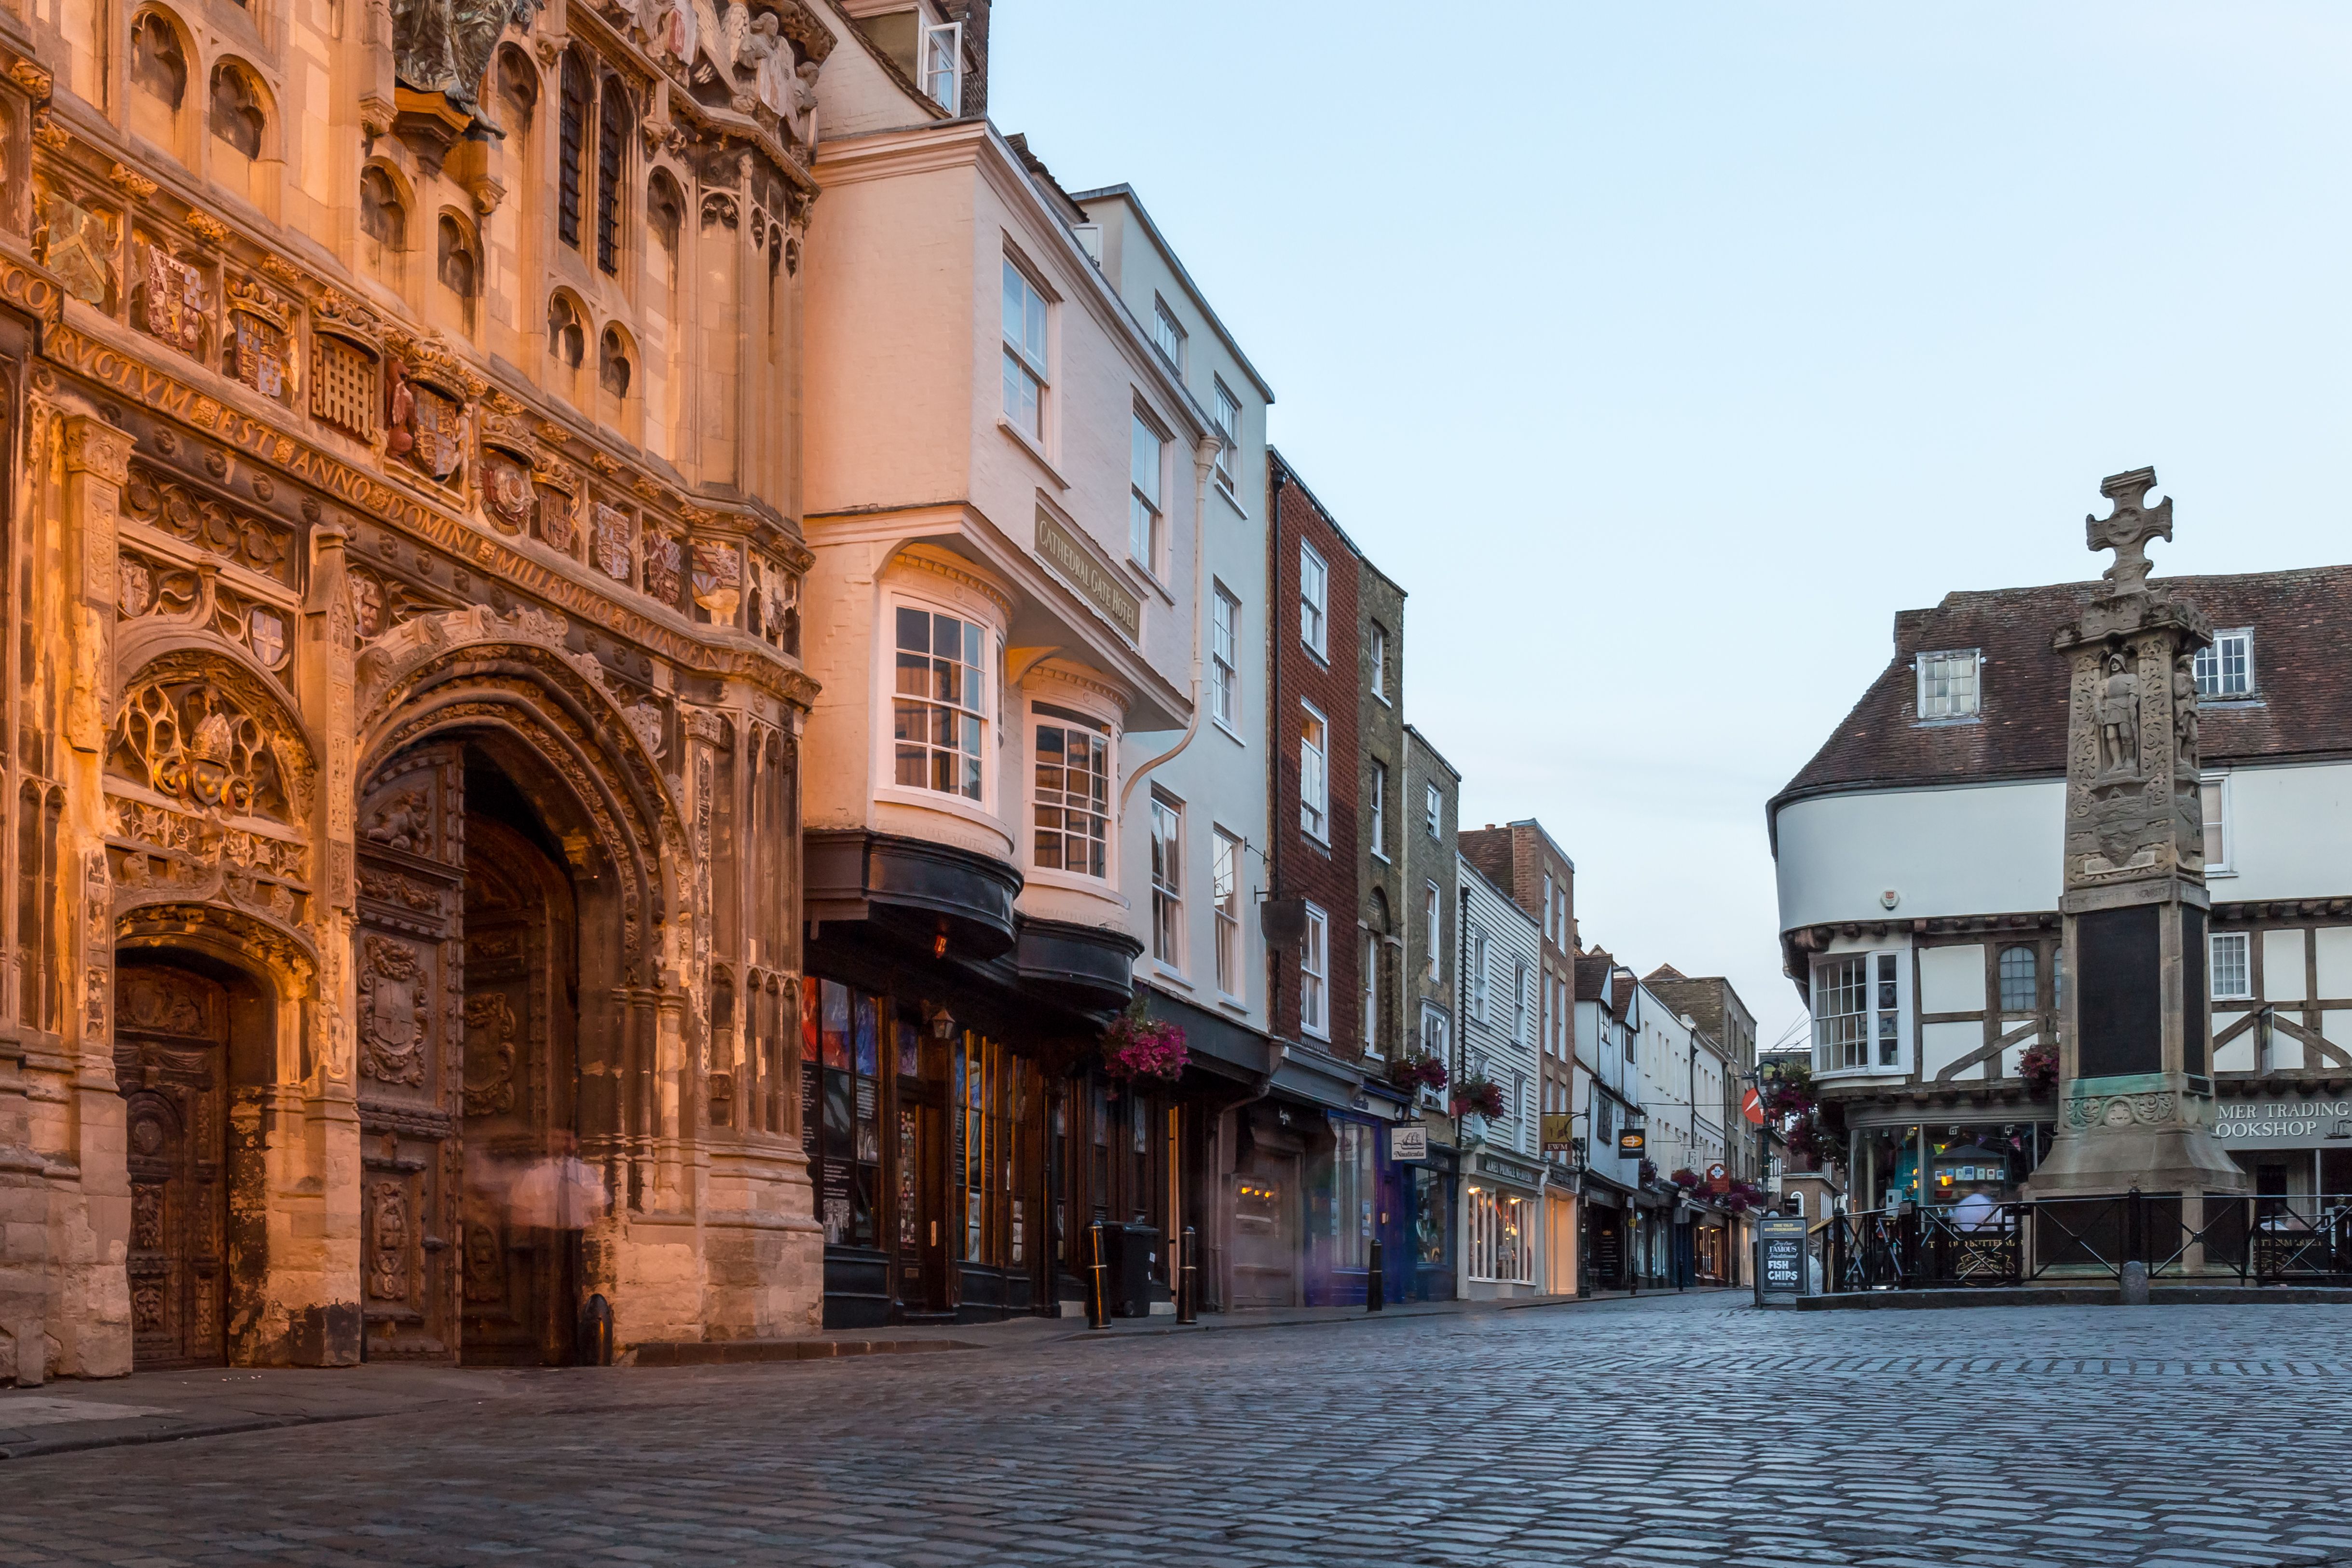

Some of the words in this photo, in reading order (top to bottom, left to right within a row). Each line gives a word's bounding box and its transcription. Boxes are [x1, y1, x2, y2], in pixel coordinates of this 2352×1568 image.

[215, 407, 277, 453] EST
[290, 450, 370, 502] ANNO
[496, 550, 609, 620] MILLESIMO
[1039, 520, 1089, 586] CATHEDRAL
[1091, 569, 1111, 608] GATE
[1112, 587, 1135, 631] HOTEL
[2215, 1104, 2257, 1119] MER
[2264, 1102, 2350, 1118] TRADING
[2216, 1121, 2317, 1138] OOKSHOP
[1767, 1260, 1789, 1269] FISH
[1767, 1271, 1798, 1281] CHIPS
